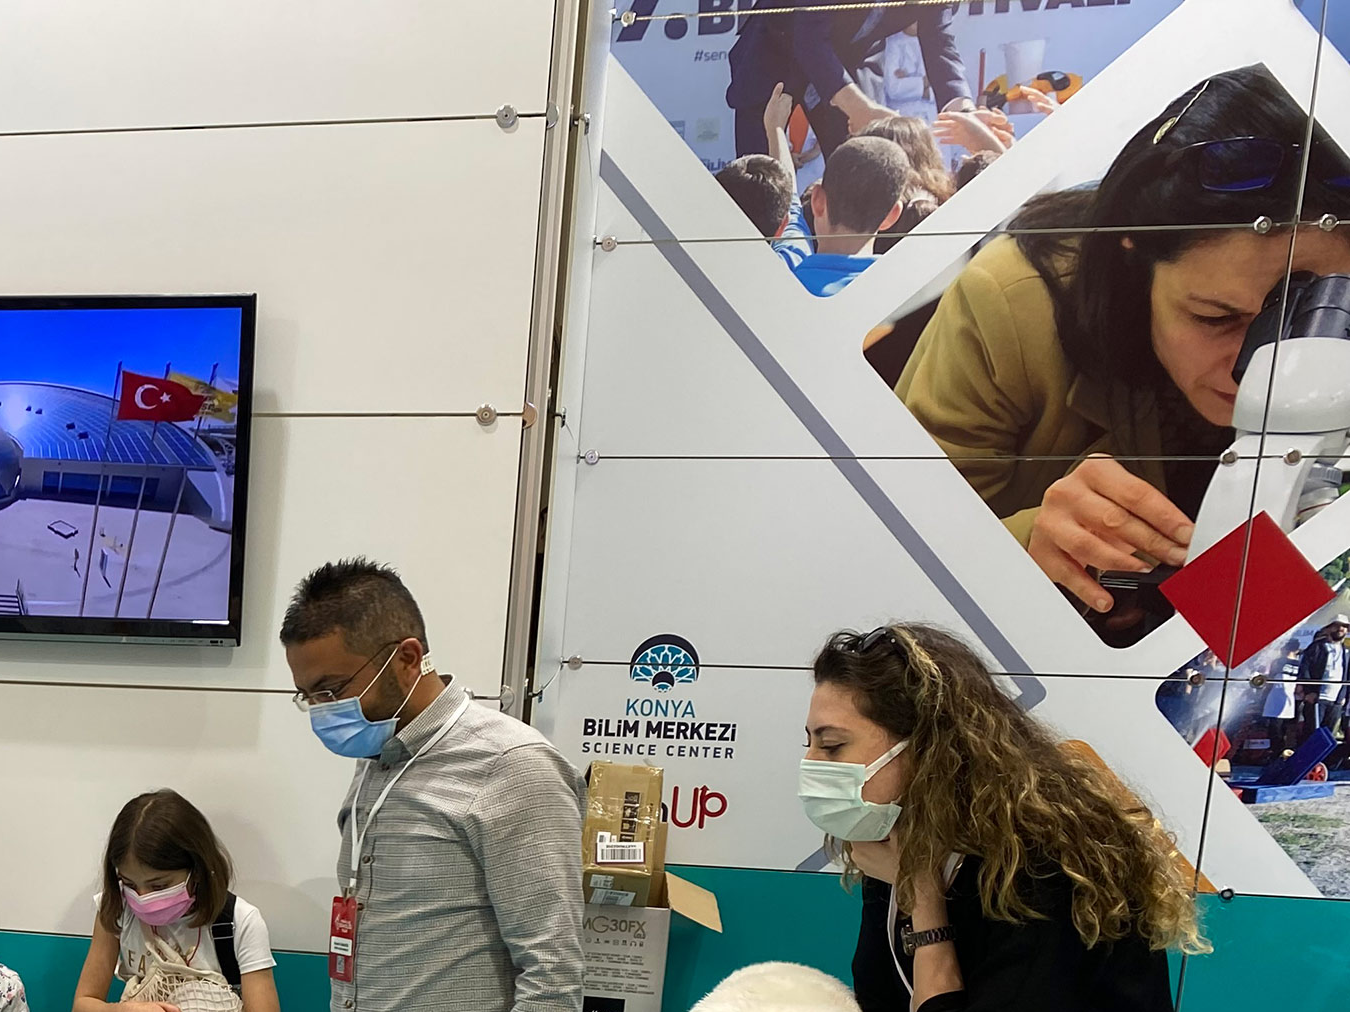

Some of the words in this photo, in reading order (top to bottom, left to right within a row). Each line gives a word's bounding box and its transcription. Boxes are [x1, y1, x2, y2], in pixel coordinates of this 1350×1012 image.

[625, 698, 696, 719] KONYA
[582, 742, 657, 756] SCIENCE
[666, 745, 734, 760] CENTER
